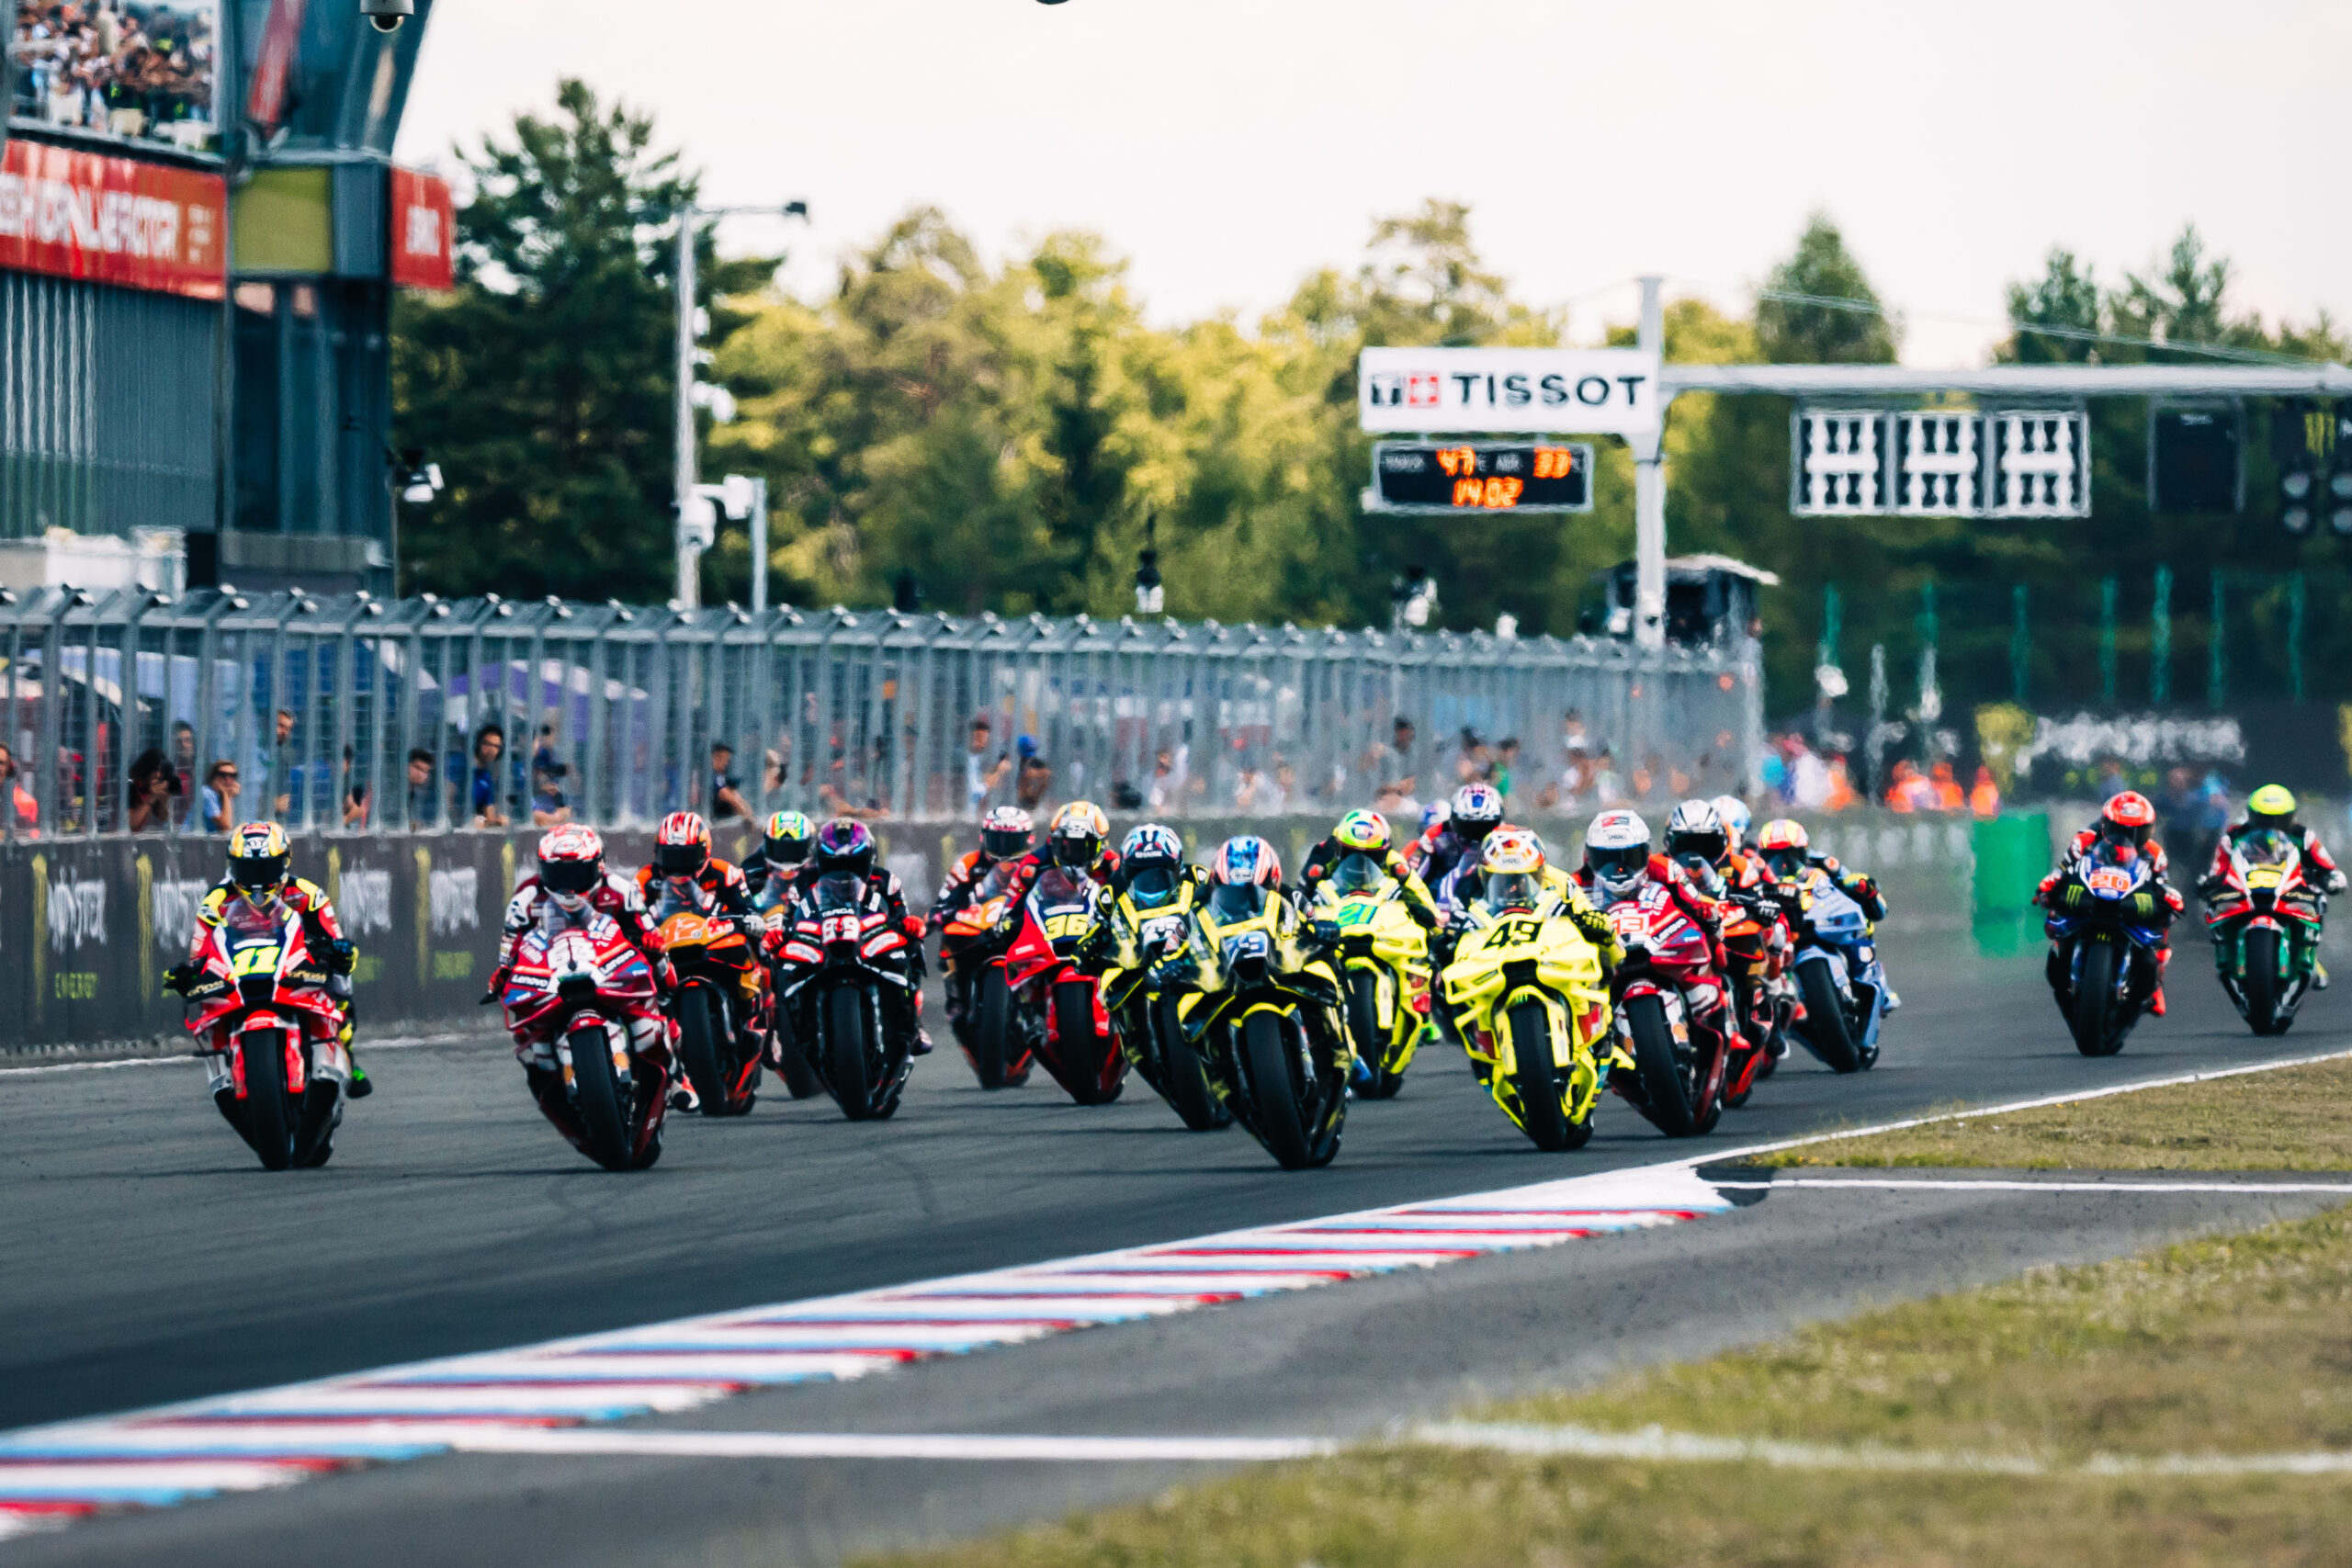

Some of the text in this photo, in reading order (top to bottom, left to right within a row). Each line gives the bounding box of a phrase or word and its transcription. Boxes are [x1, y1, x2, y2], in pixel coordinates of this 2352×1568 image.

[1451, 374, 1645, 406] TISSOT
[663, 917, 705, 943] 12
[822, 915, 859, 945] 89
[1043, 914, 1090, 942] 36
[1482, 920, 1544, 950] 49
[1652, 917, 1689, 943] Lenovo
[228, 946, 280, 980] 11
[599, 949, 636, 975] Lenovo
[511, 974, 548, 987] Lenovo
